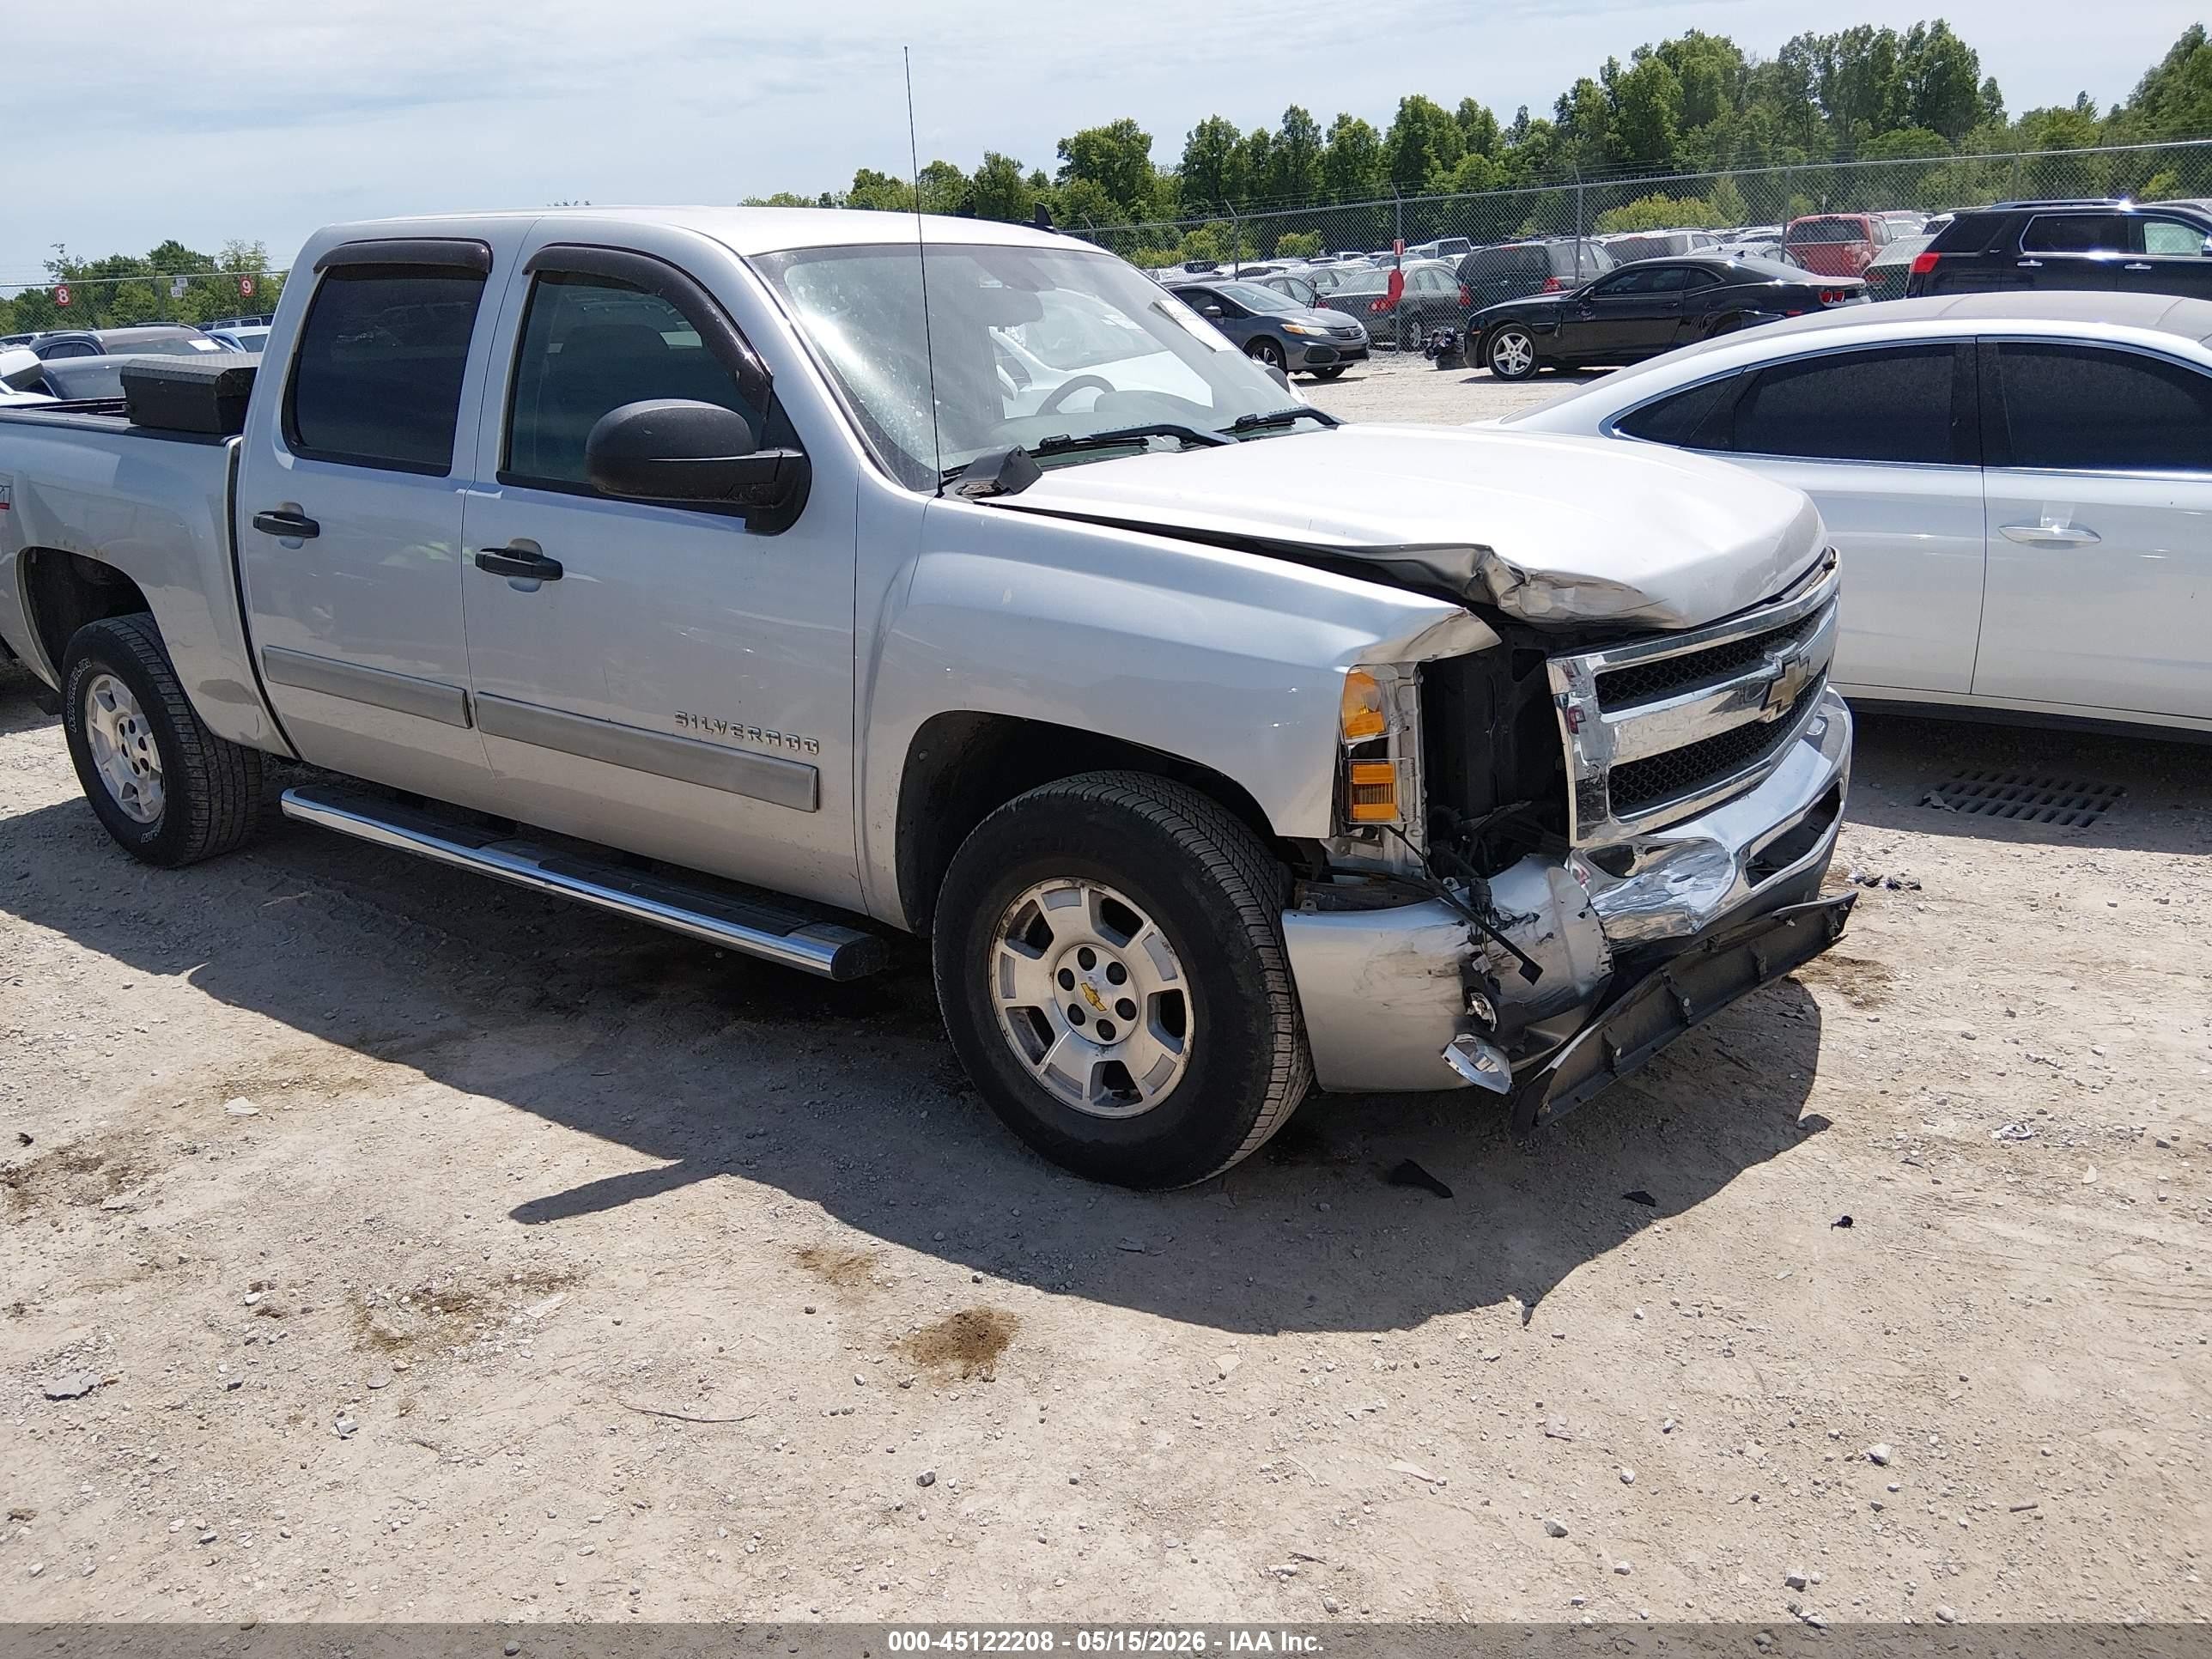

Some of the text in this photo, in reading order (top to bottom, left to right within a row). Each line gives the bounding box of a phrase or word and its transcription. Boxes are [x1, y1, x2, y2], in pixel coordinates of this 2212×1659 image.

[242, 280, 252, 294] 9
[58, 289, 70, 303] 8
[673, 710, 819, 755] SILVERADO
